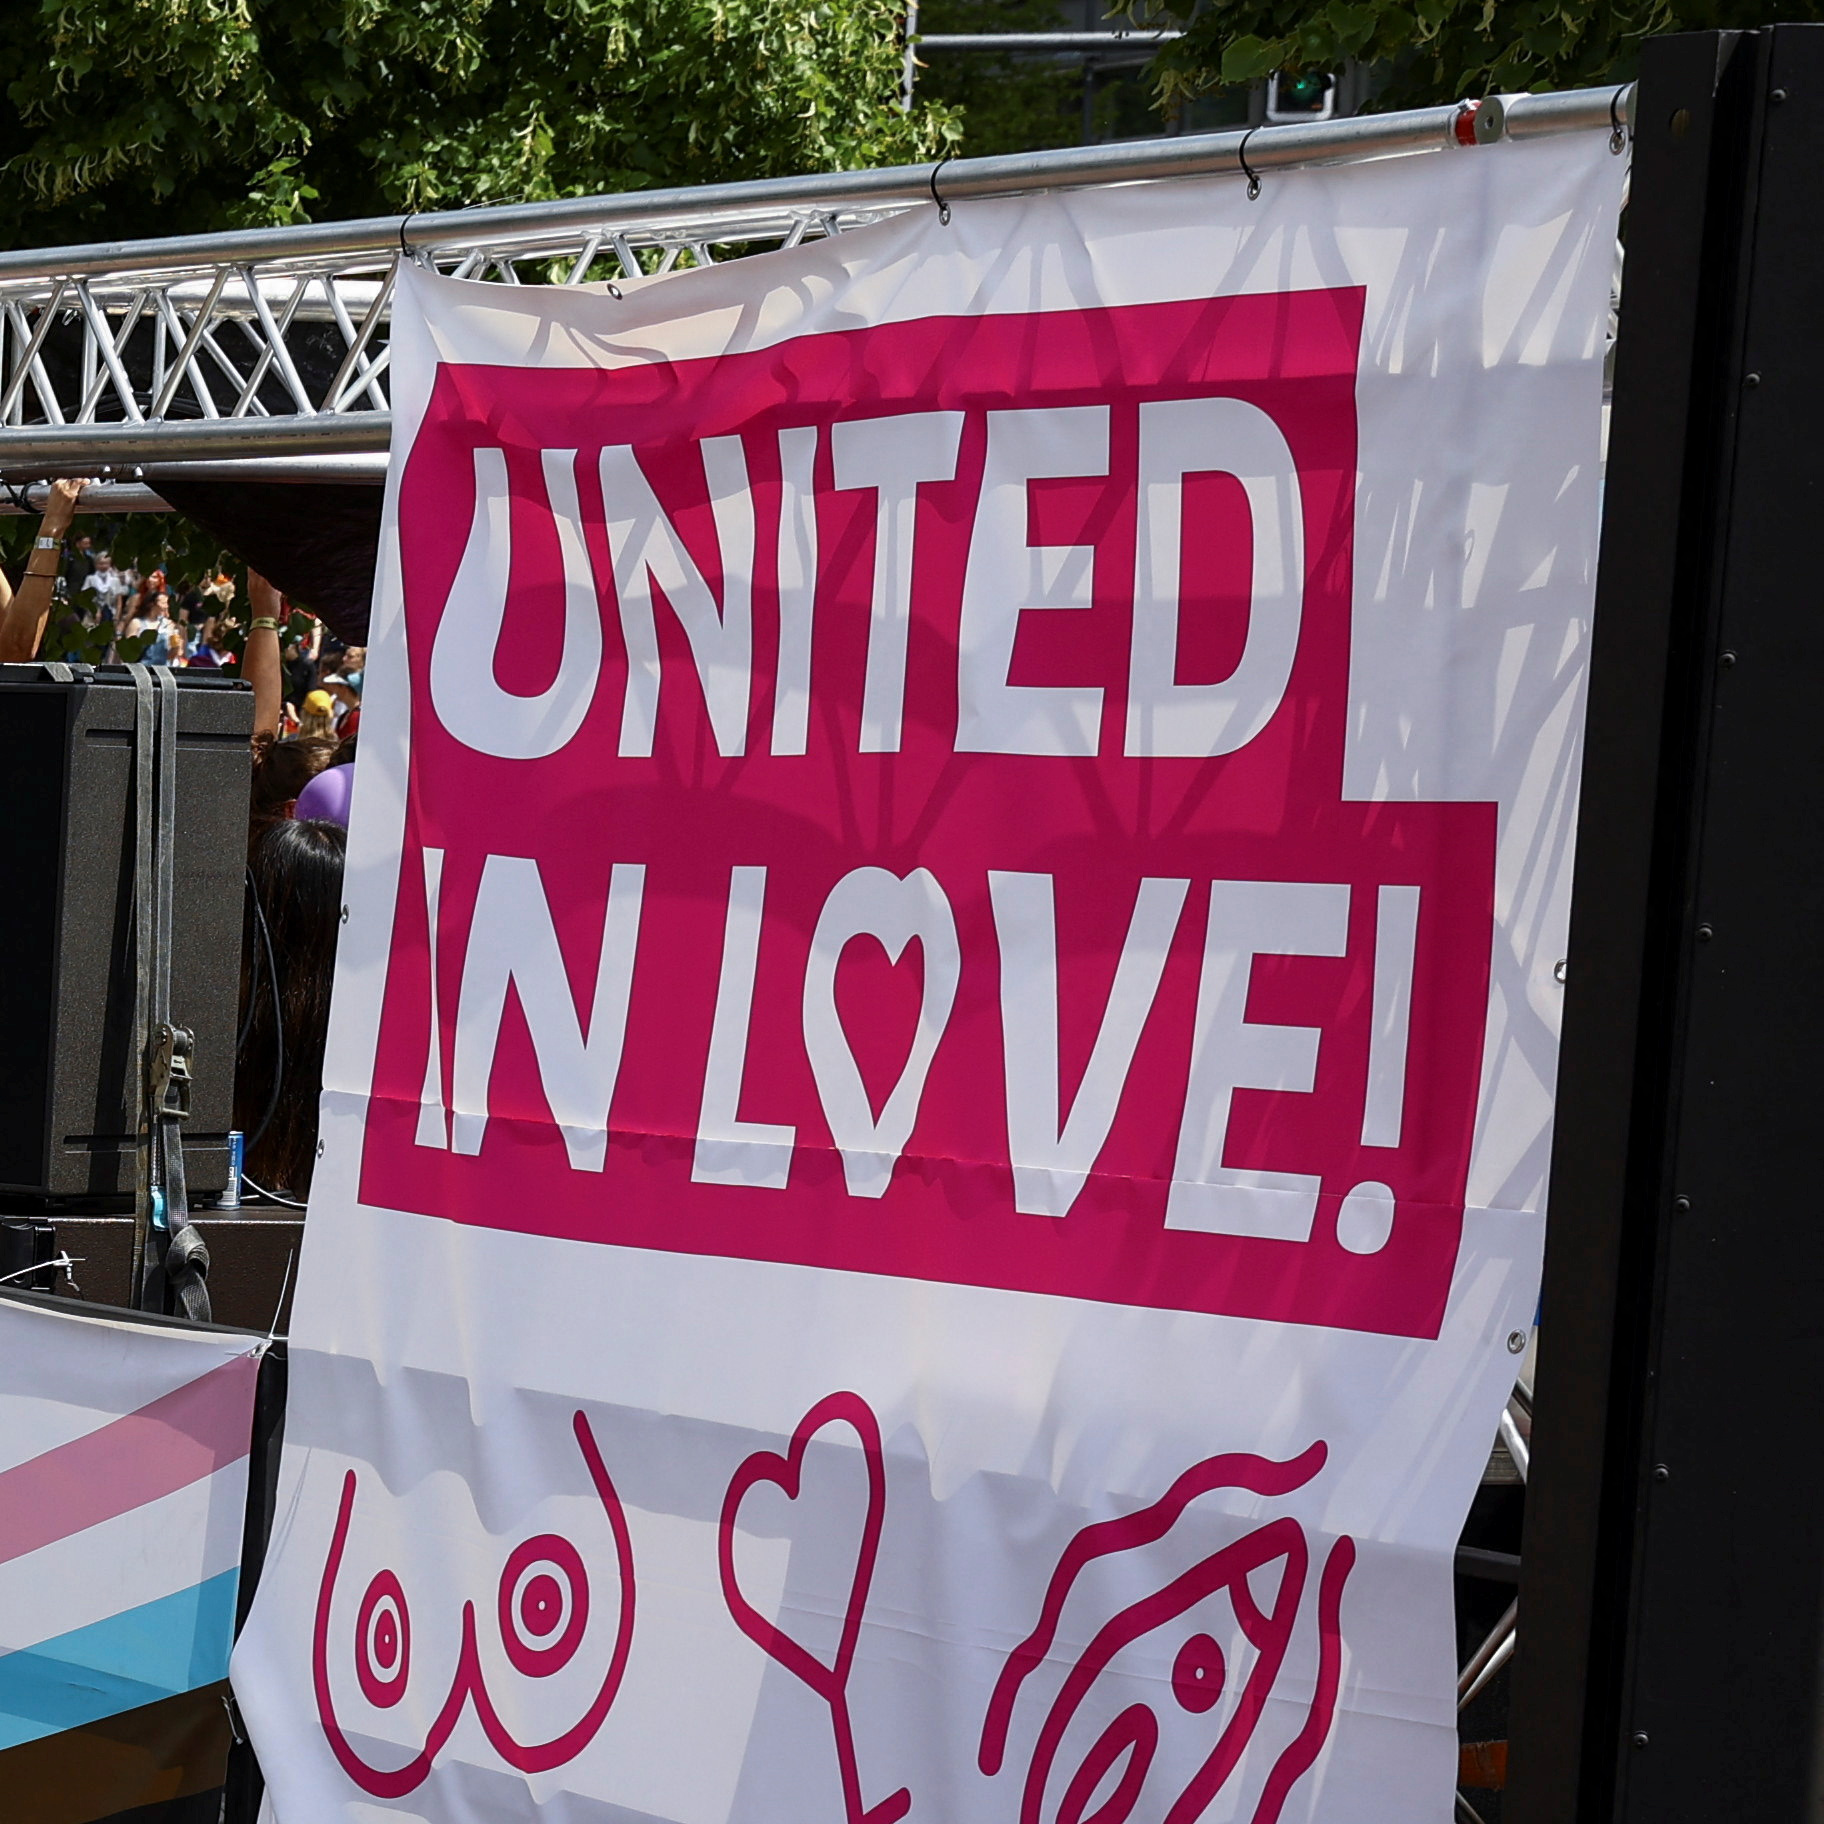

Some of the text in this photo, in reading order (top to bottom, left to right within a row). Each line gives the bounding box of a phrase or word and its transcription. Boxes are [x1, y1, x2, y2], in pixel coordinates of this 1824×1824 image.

[428, 396, 1305, 759] UNITED
[414, 846, 1421, 1257] IN LOVE!
